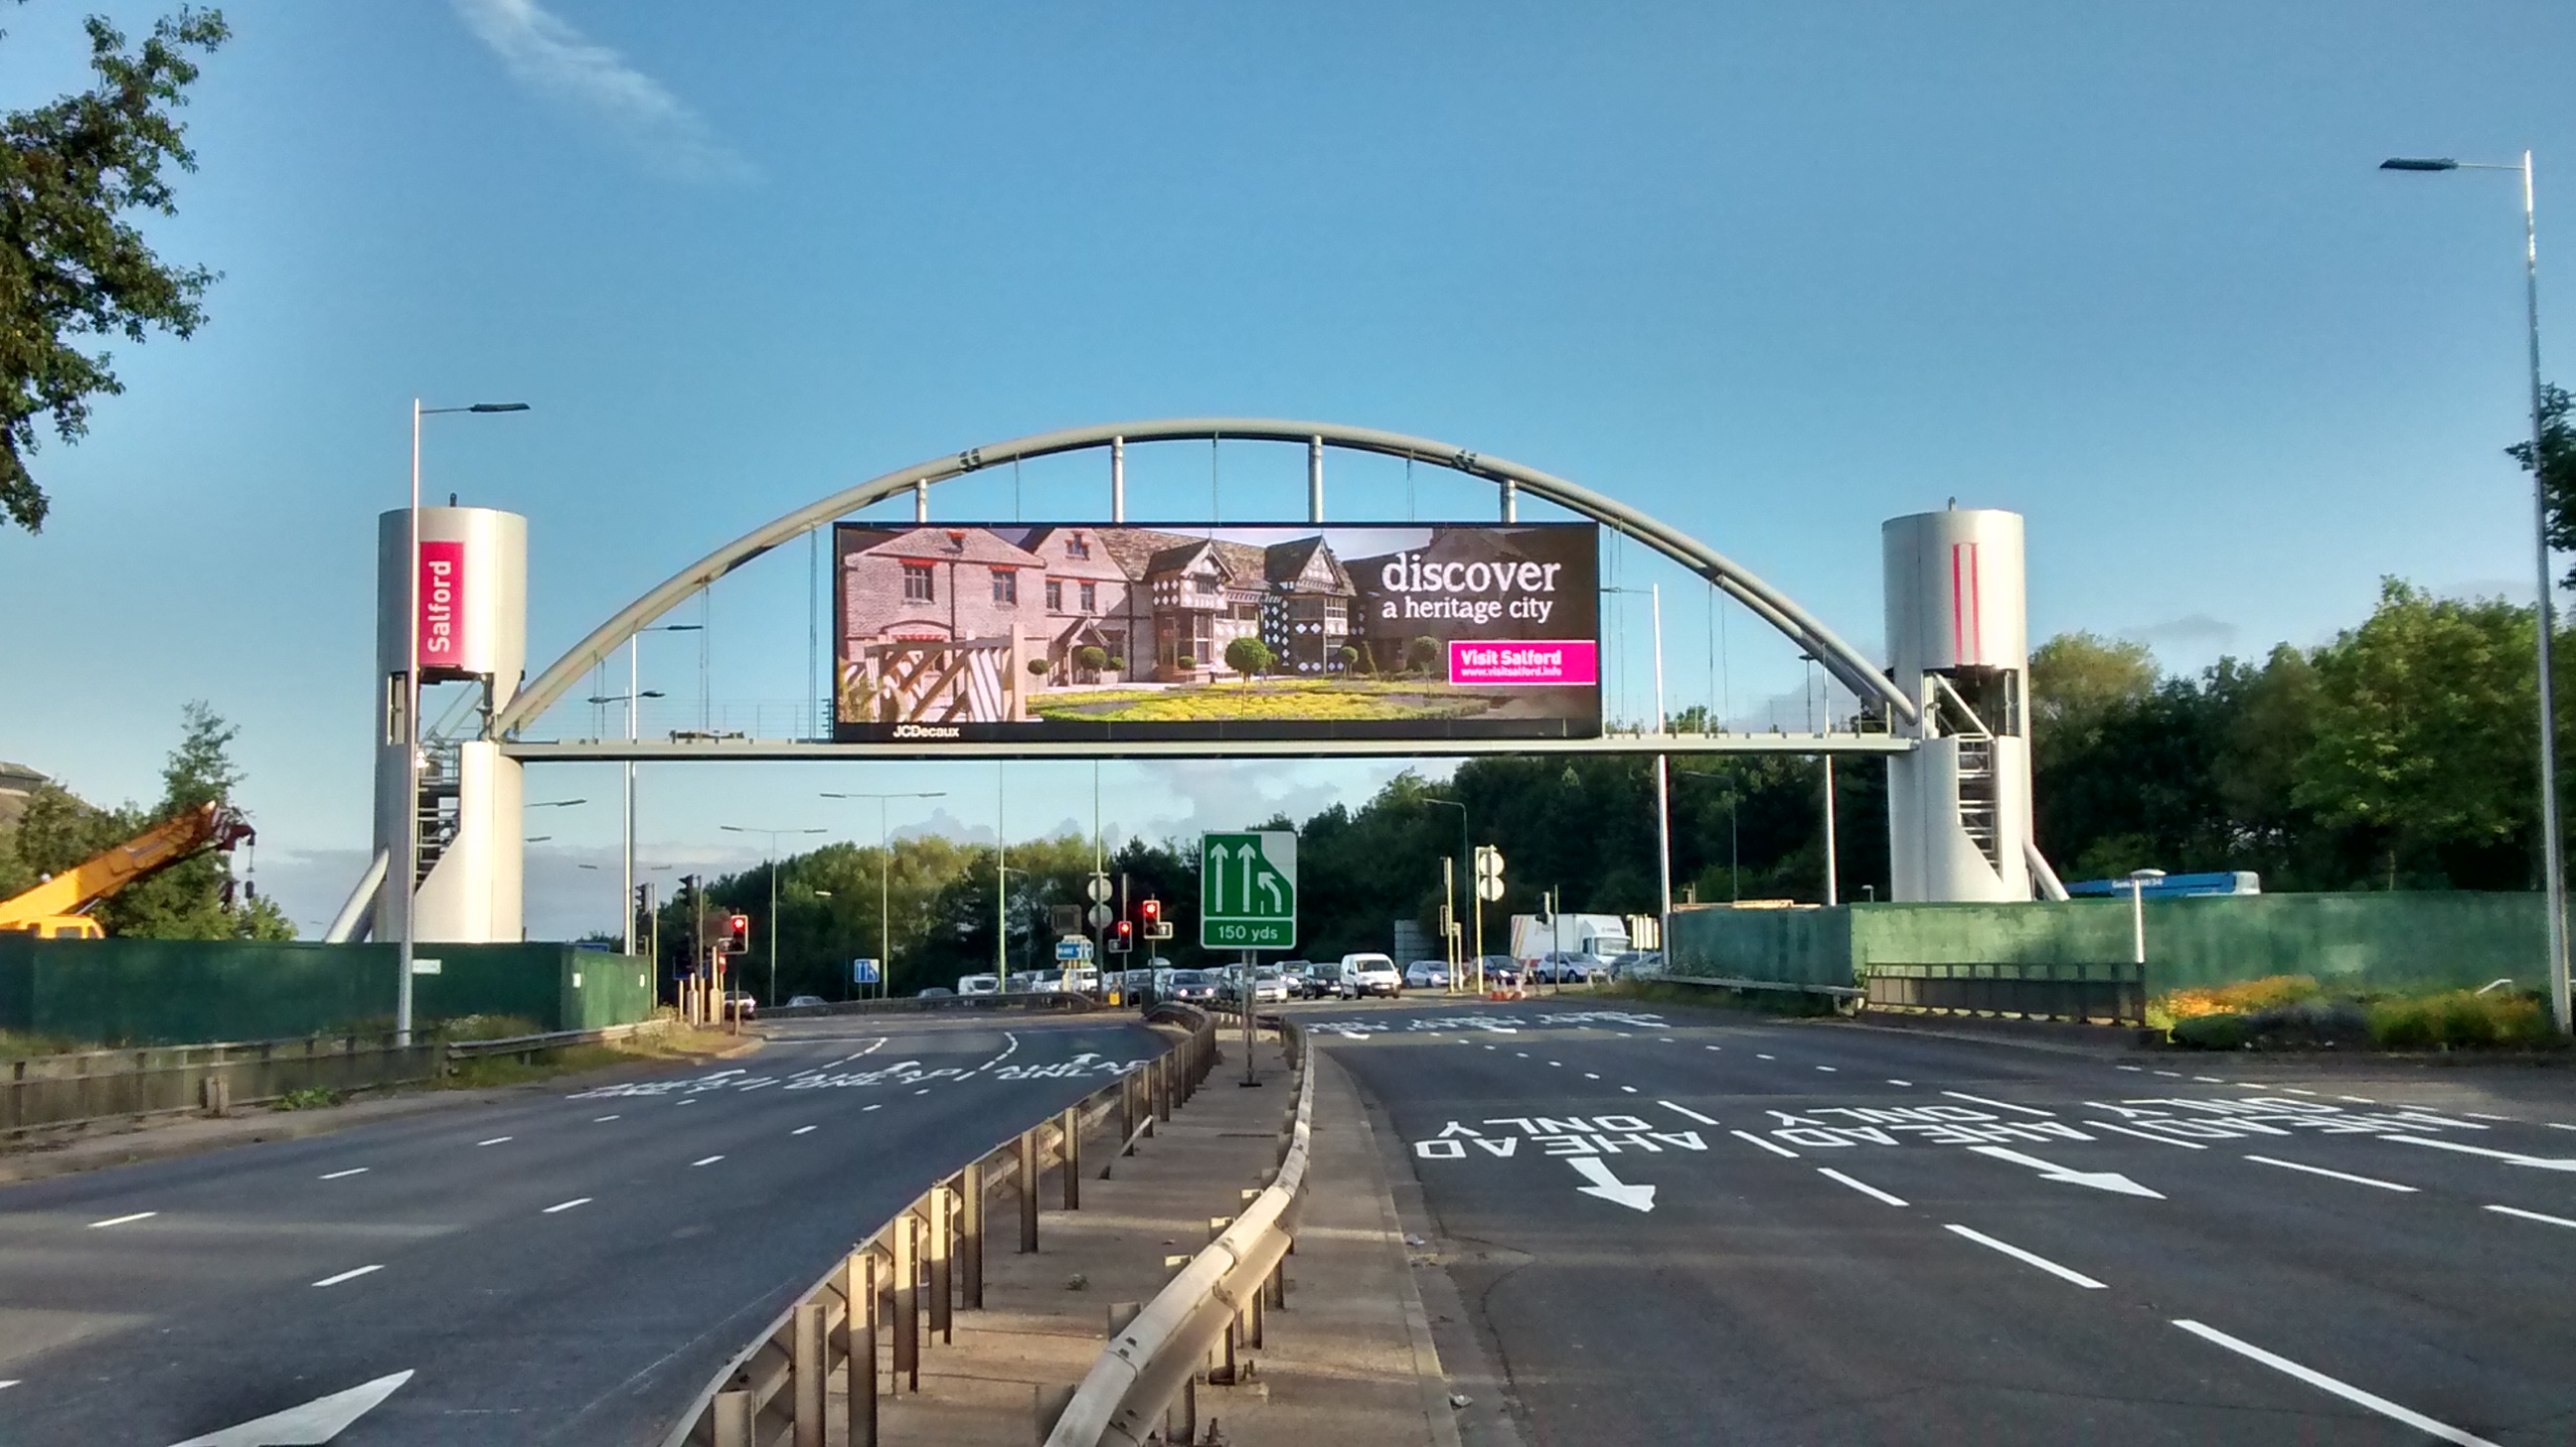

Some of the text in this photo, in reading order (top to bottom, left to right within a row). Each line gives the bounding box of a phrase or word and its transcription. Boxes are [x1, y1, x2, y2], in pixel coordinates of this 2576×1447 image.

[1381, 553, 1561, 592] discover
[427, 561, 451, 653] Salford
[1381, 596, 1553, 624] a heritage city
[1461, 649, 1562, 666] Visit Salford
[1461, 667, 1562, 677] www.visitsalford.info
[892, 724, 960, 737] JCDecaux
[1218, 925, 1278, 942] 150 yds
[1437, 1115, 1653, 1137] ONLY
[1765, 1106, 2000, 1126] ONLY
[2131, 1112, 2492, 1139] AHEAD
[1414, 1131, 1708, 1158] AHEAD
[1771, 1122, 2098, 1146] AHEAD
